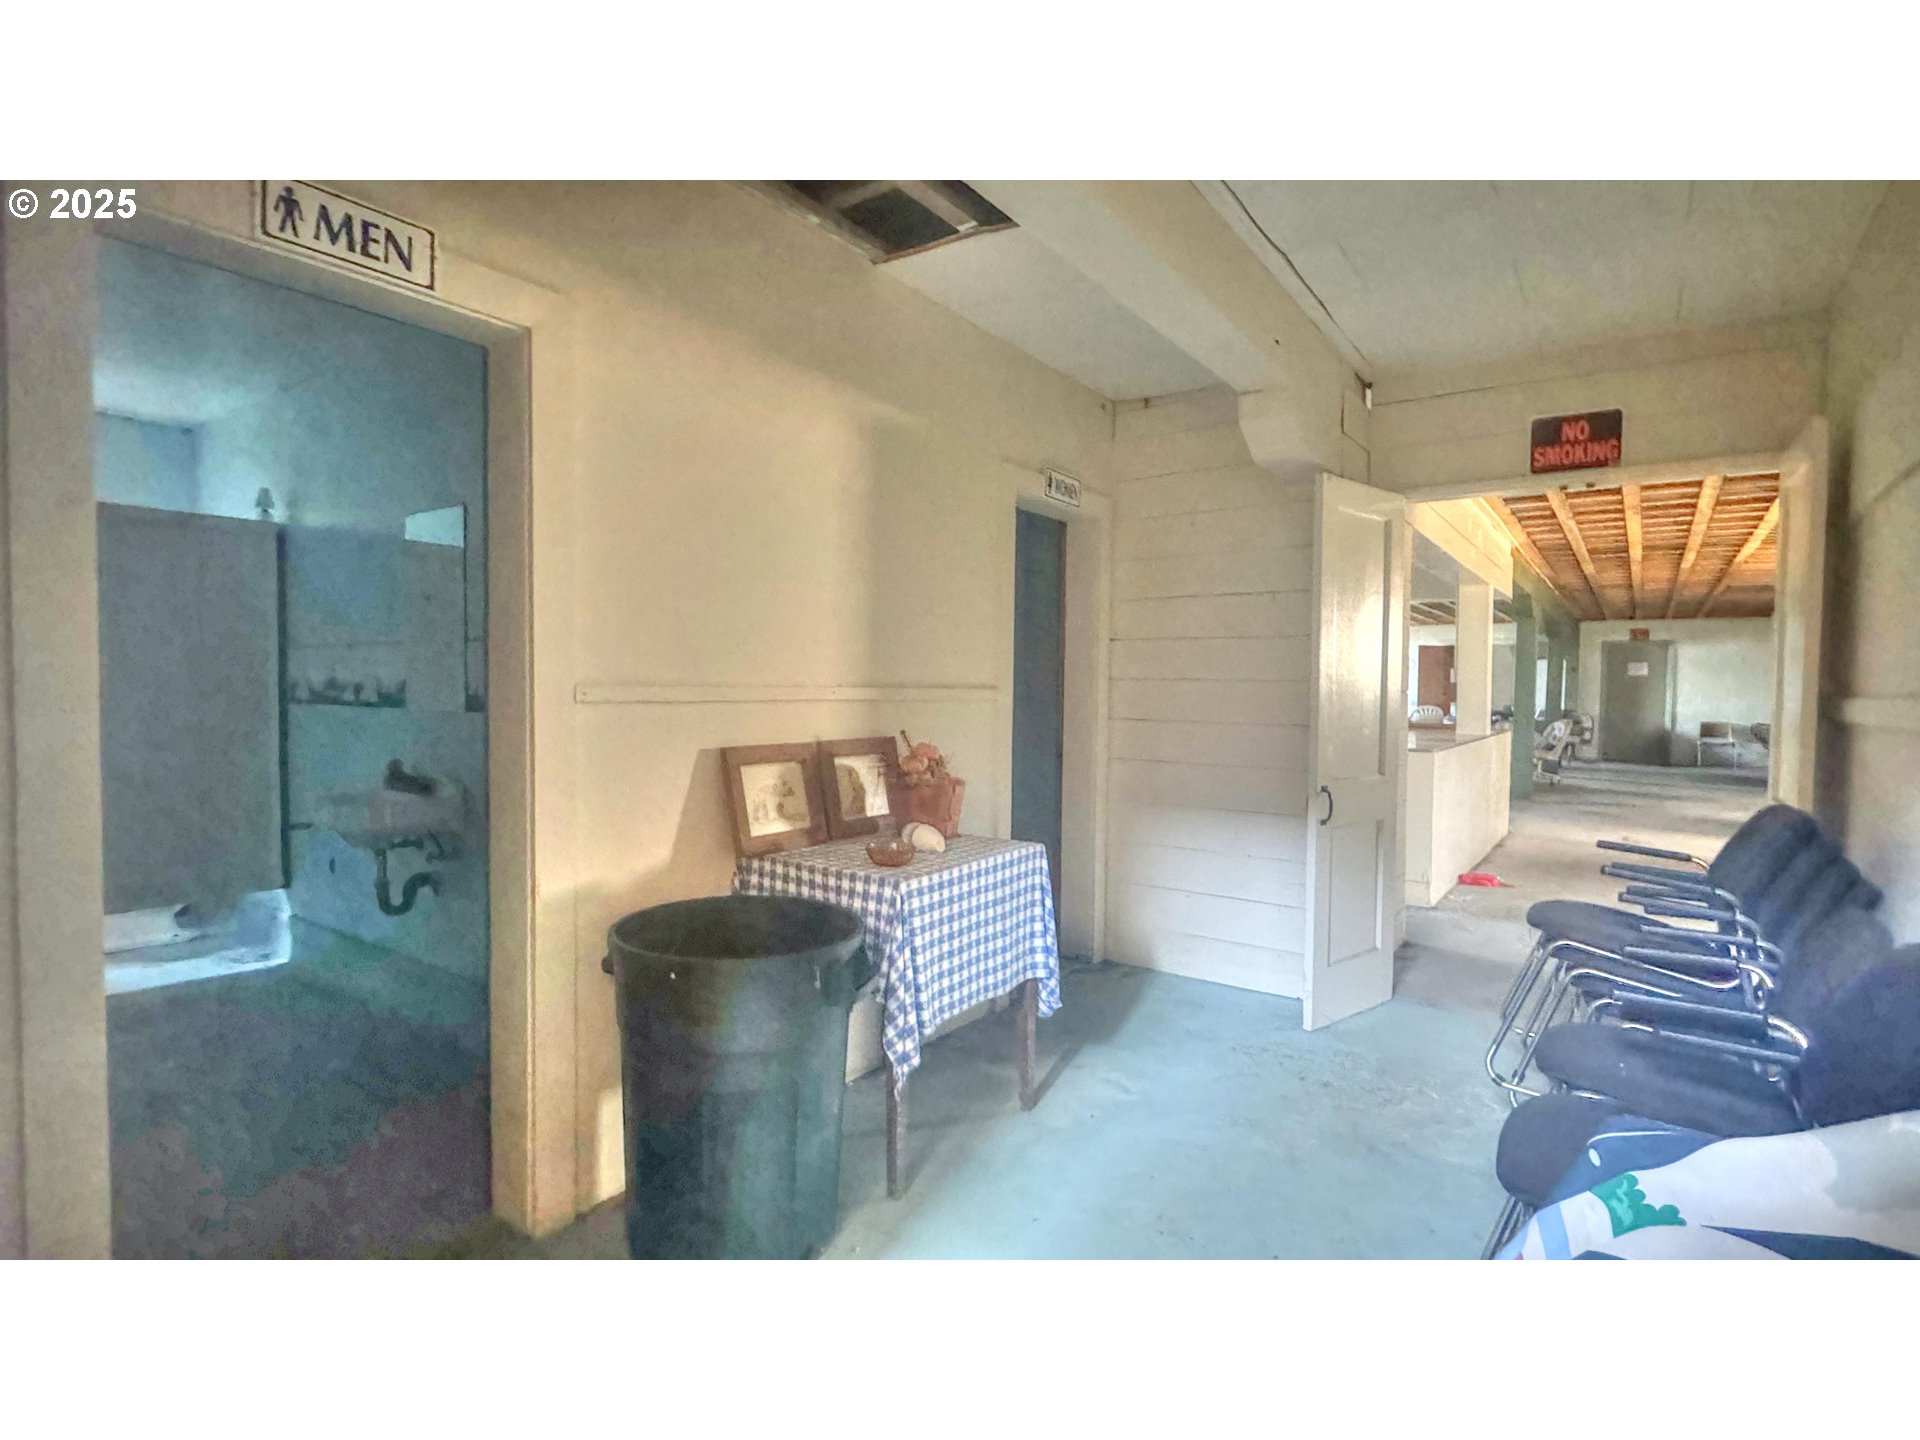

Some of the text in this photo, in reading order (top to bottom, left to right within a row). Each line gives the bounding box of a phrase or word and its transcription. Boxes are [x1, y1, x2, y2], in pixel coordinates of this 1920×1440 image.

[313, 203, 413, 272] MEN
[1561, 419, 1590, 440] NO
[1533, 439, 1619, 468] SMOKING
